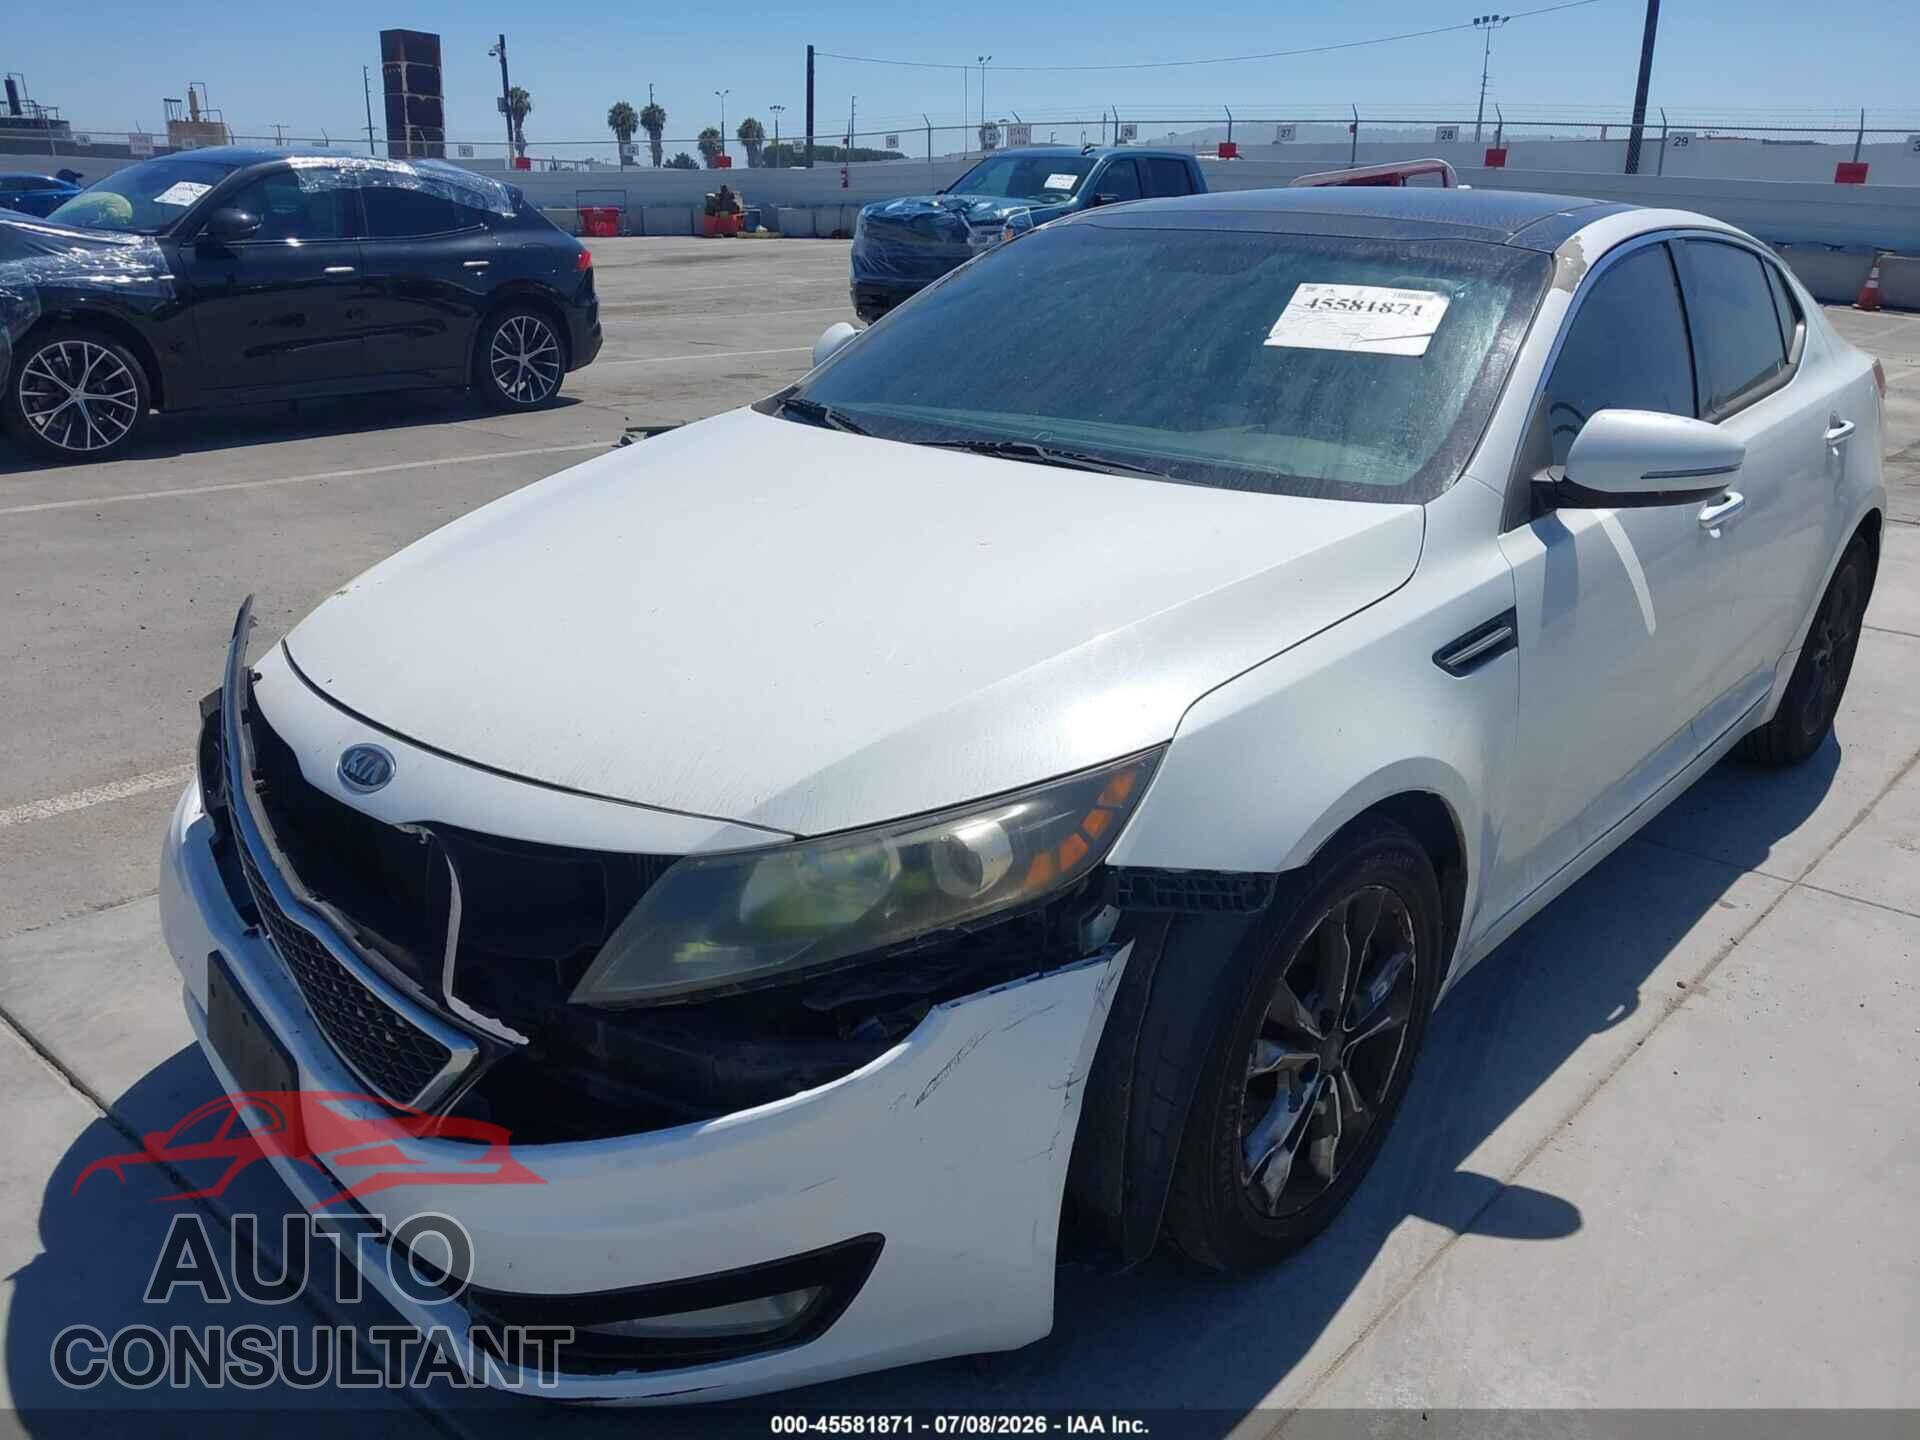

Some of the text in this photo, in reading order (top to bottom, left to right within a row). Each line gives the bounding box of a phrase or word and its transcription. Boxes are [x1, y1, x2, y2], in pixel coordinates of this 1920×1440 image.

[1280, 128, 1291, 138] 27
[1440, 130, 1453, 140] 28
[1673, 136, 1688, 147] 29
[1304, 297, 1422, 316] 45581871
